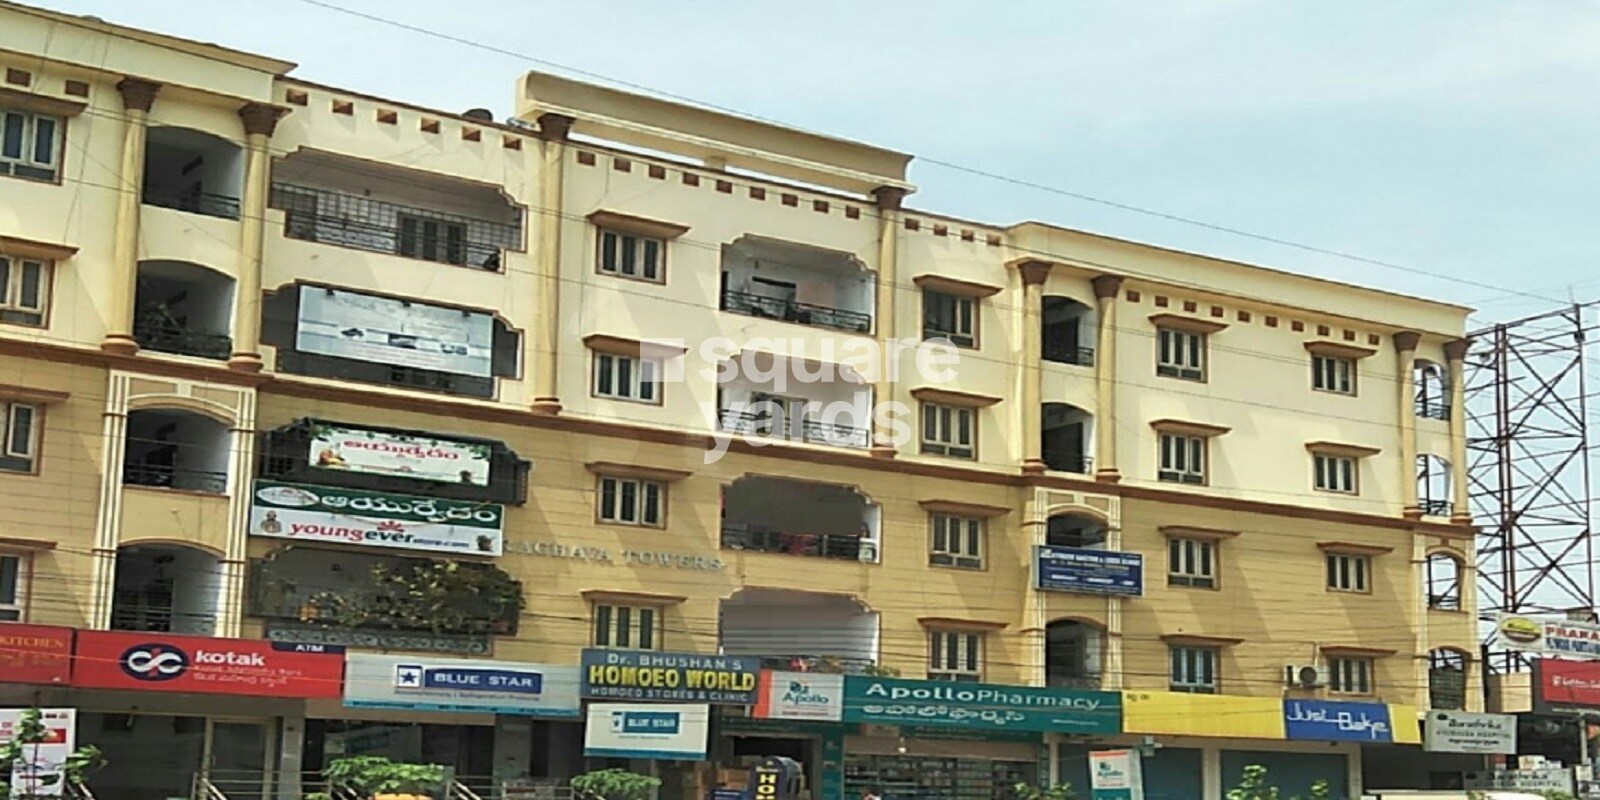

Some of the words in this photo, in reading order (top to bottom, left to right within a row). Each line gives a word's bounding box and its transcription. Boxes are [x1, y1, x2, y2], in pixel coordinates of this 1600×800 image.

[625, 550, 720, 570] TOWERS
[196, 650, 265, 666] kotak
[607, 653, 632, 665] Dr.
[640, 655, 742, 670] BHUSHAN'S
[434, 673, 479, 685] BLUE
[488, 676, 532, 687] STAR
[589, 666, 679, 687] HOMOEO
[685, 670, 755, 691] WORLD
[782, 692, 829, 705] Apollo
